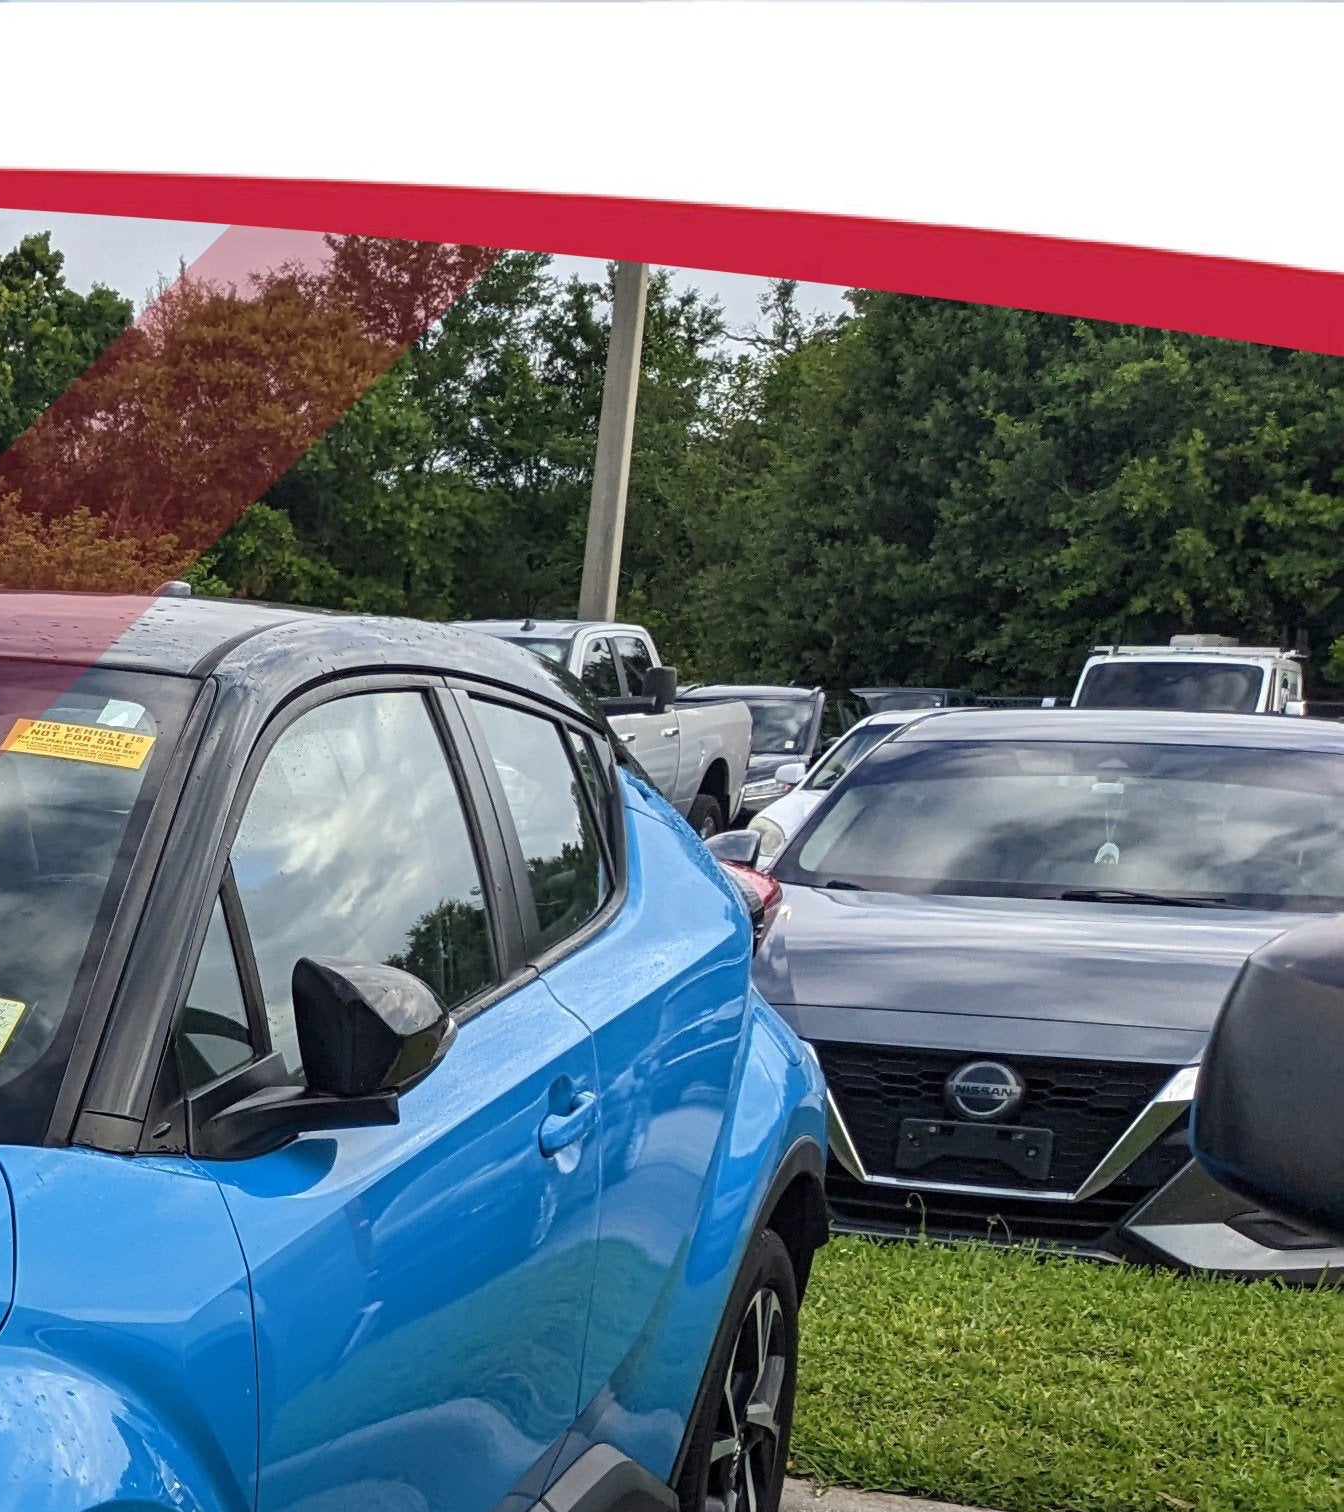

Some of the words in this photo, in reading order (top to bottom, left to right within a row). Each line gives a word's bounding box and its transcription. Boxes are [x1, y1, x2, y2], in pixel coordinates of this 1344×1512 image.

[30, 721, 61, 731] THIS
[66, 726, 126, 740] VEHICLE
[130, 735, 145, 743] IS
[31, 729, 60, 738] NOT
[64, 733, 92, 743] FOR
[97, 737, 133, 748] SALE
[954, 1084, 1013, 1097] NISSAN
